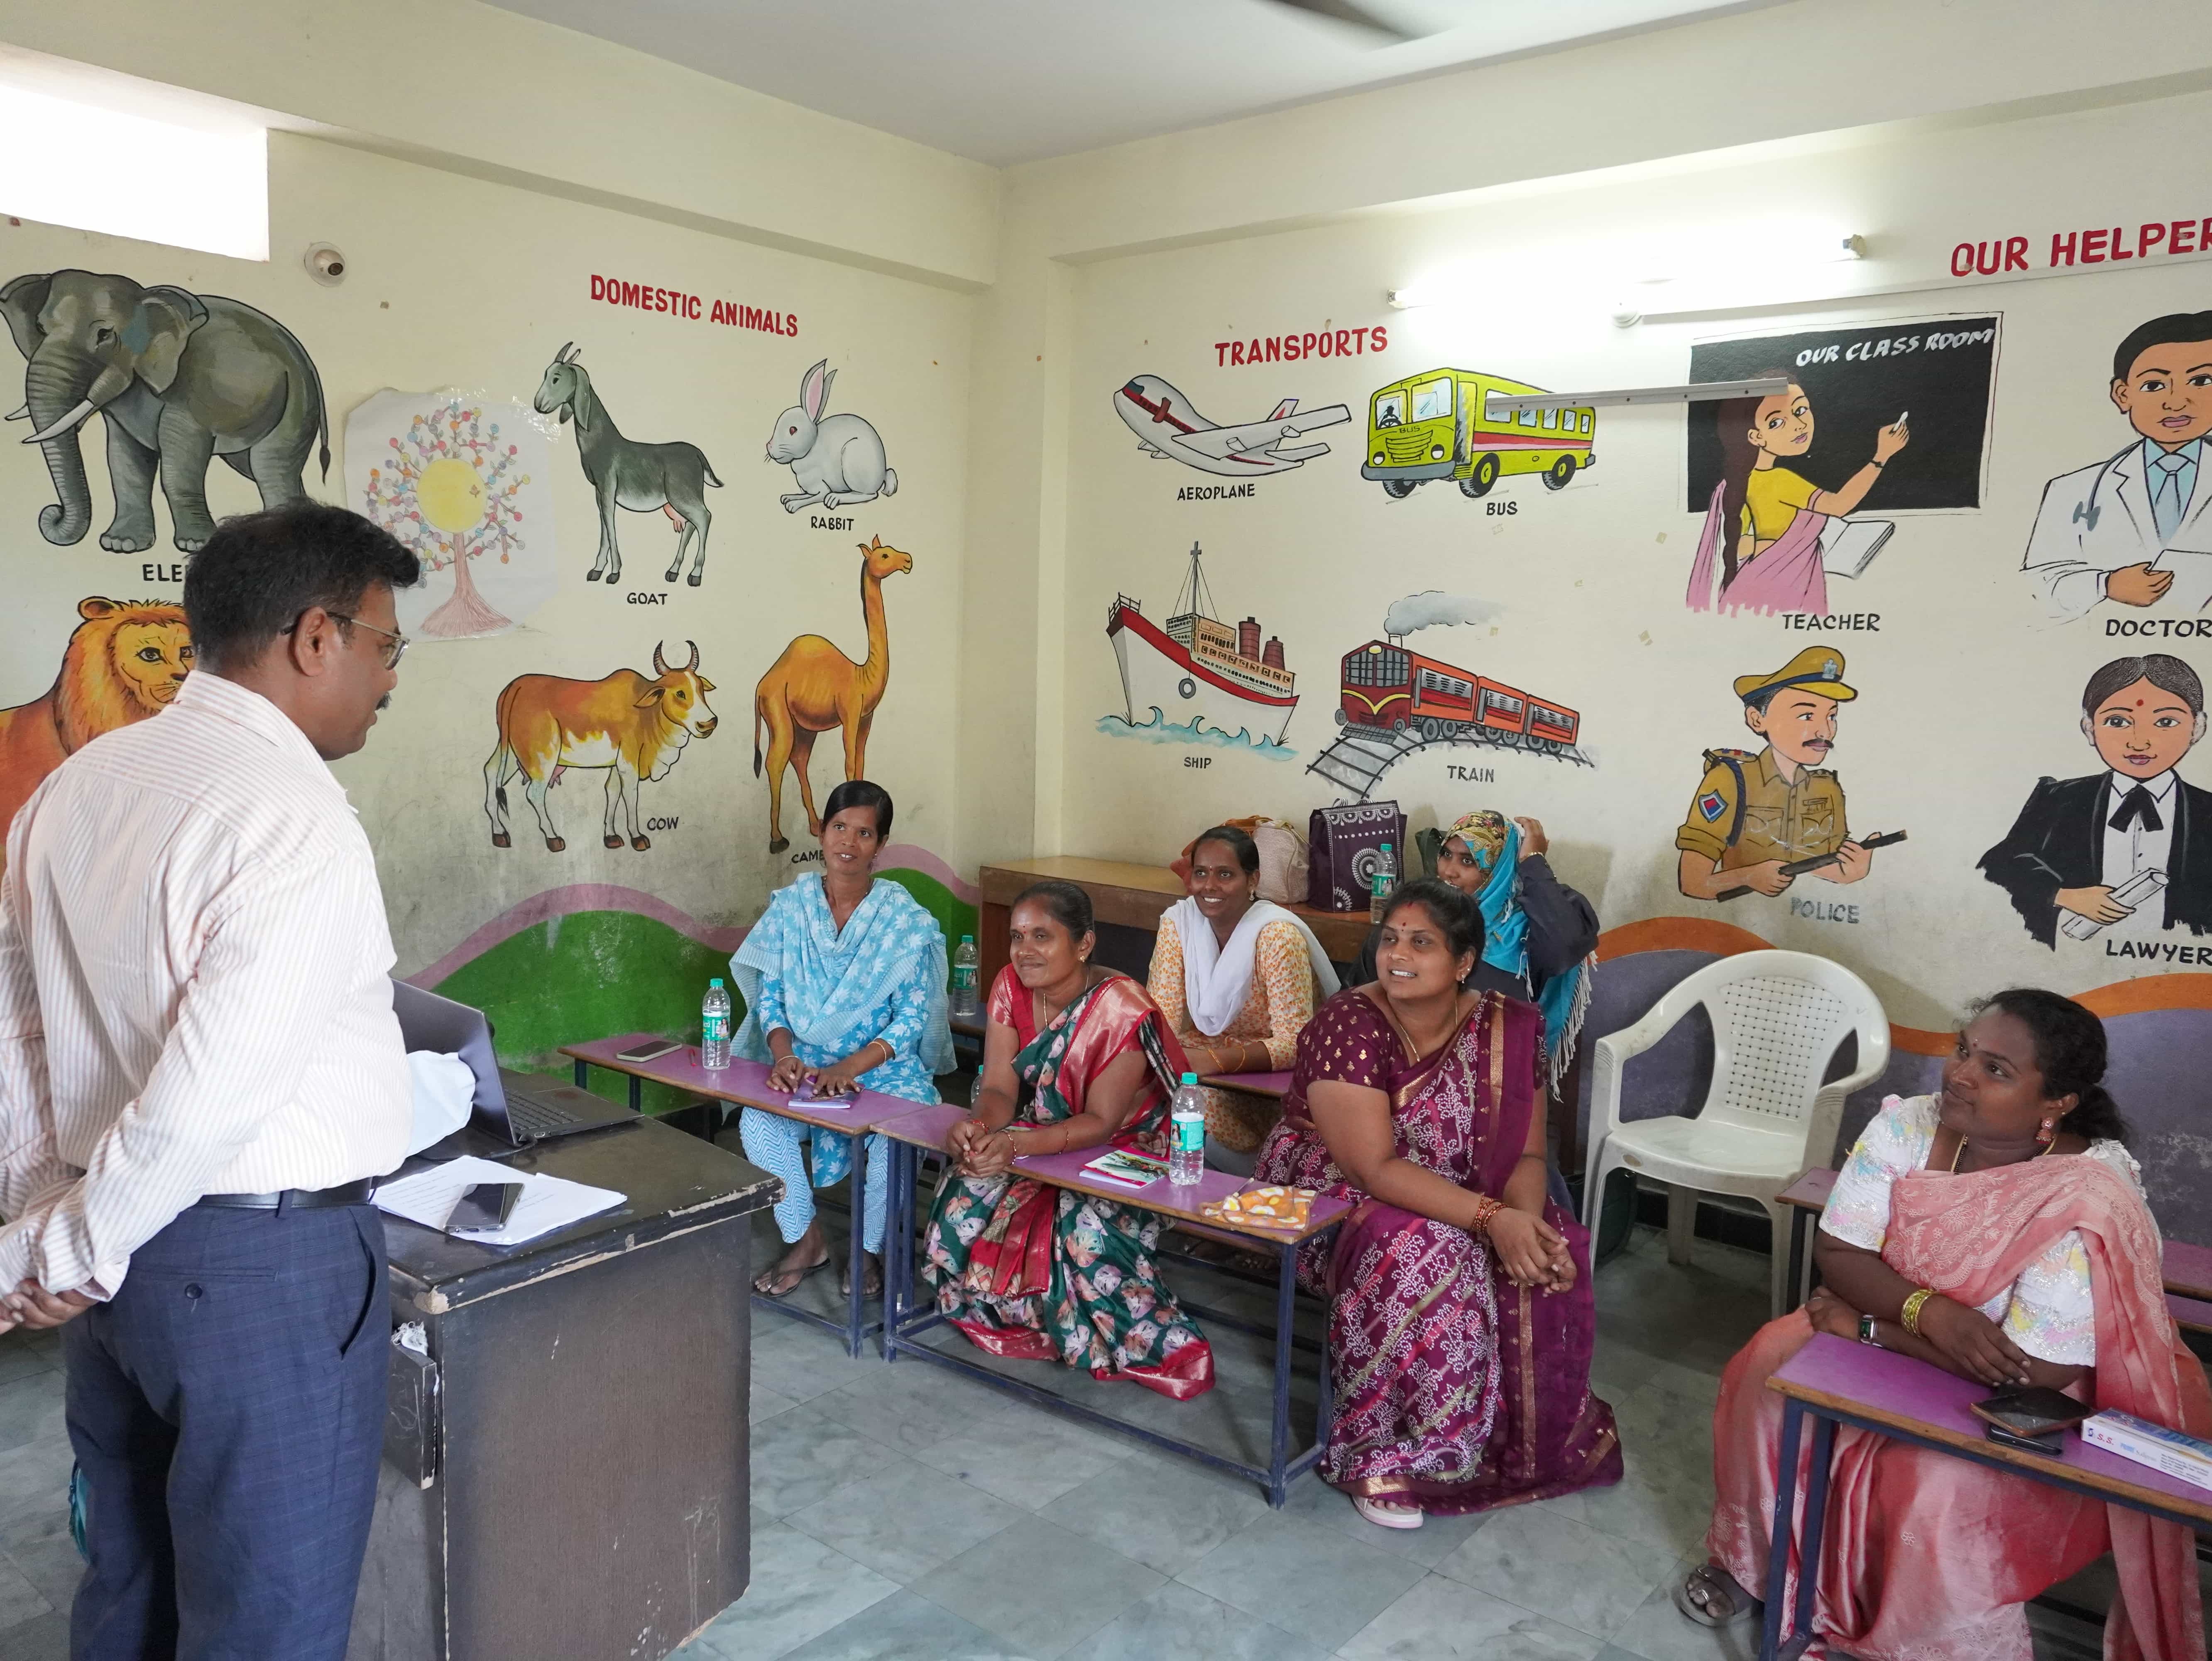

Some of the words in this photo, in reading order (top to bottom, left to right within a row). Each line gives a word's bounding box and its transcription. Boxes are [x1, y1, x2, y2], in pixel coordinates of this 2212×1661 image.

[1952, 237, 2028, 277] OUR
[591, 275, 701, 320] DOMESTIC
[710, 300, 798, 337] ANIMALS
[1215, 326, 1387, 367] TRANSPORTS
[1796, 345, 1840, 367] OUR
[1845, 336, 1921, 361] CLASS
[1923, 328, 1995, 352] ROOM
[1177, 483, 1255, 501] AEROPLANE
[1486, 501, 1518, 516] BUS
[811, 516, 854, 531] RABBIT
[627, 593, 668, 605] GOAT
[1782, 613, 1880, 632] TEACHER
[2106, 619, 2212, 637] DOCTOR
[1184, 757, 1212, 769] SHIP
[1447, 765, 1494, 783] TRAIN
[647, 816, 679, 830] COW
[791, 850, 825, 863] CAME
[1790, 897, 1860, 924] POLICE
[2106, 939, 2212, 966] LAWYER
